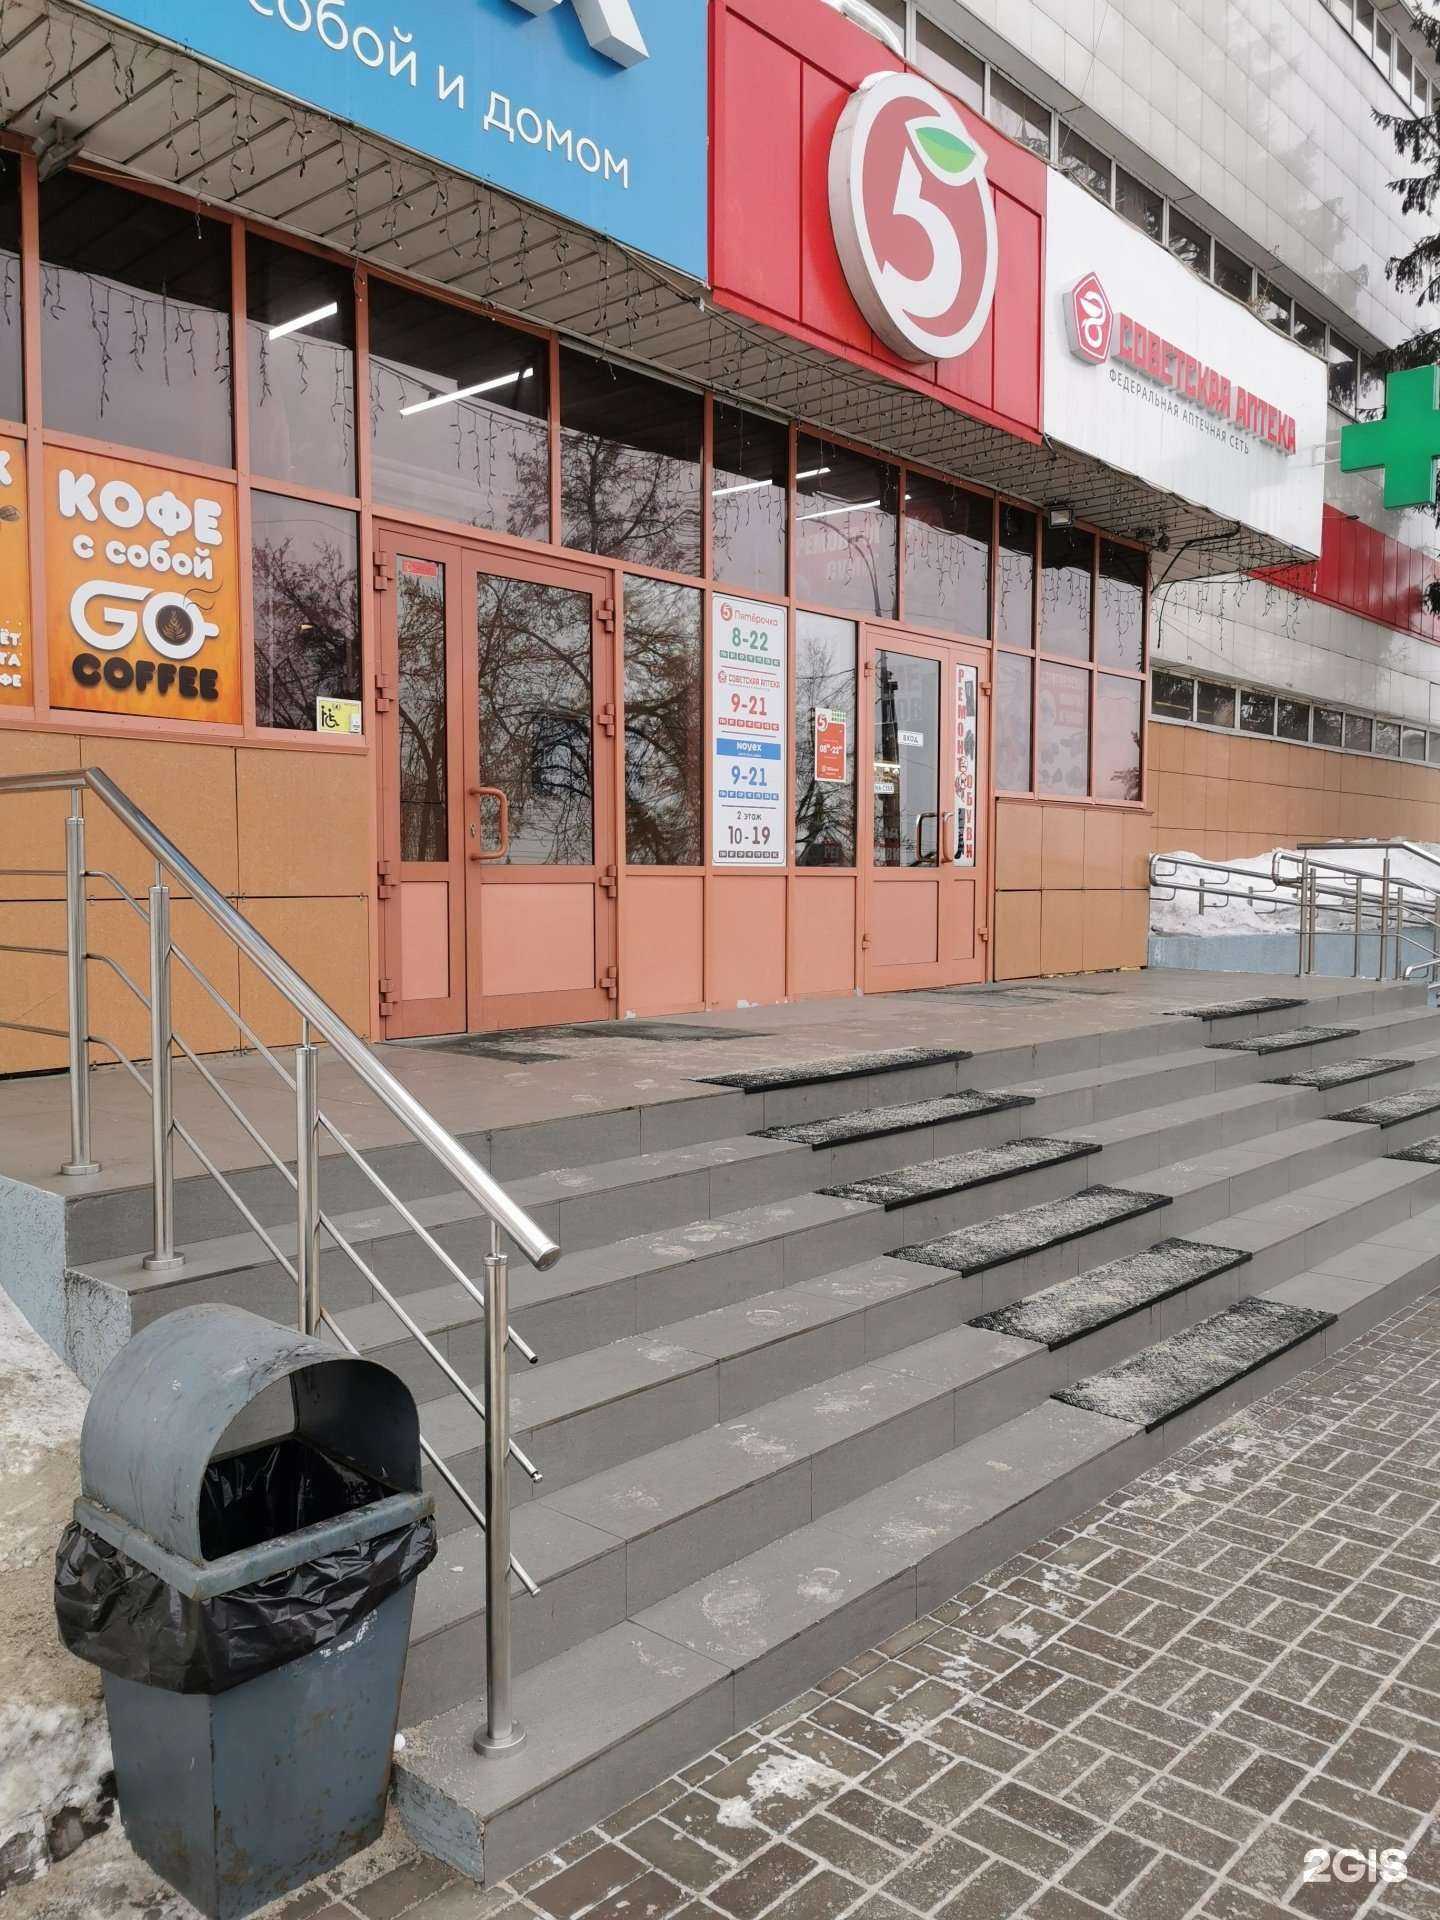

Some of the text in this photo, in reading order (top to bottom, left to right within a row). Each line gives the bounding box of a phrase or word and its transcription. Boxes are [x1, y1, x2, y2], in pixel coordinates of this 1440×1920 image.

[437, 64, 464, 109] и
[483, 91, 630, 188] домом
[1109, 368, 1249, 454] ФЕДЕРАЛЬНАЯ АПТЕЧНАЯ СЕТЬ
[1118, 312, 1296, 455] СОВЕТСКАЯ АПТЕКА
[58, 468, 224, 546] КОФЕ
[105, 539, 214, 580] собой
[69, 579, 220, 660] GO
[732, 627, 768, 652] 8-22
[71, 652, 219, 701] COFFEE
[731, 692, 767, 716] 9-21
[731, 765, 767, 786] 9-21
[737, 810, 762, 821] 2 этаж
[966, 774, 974, 859] ОБУВИ
